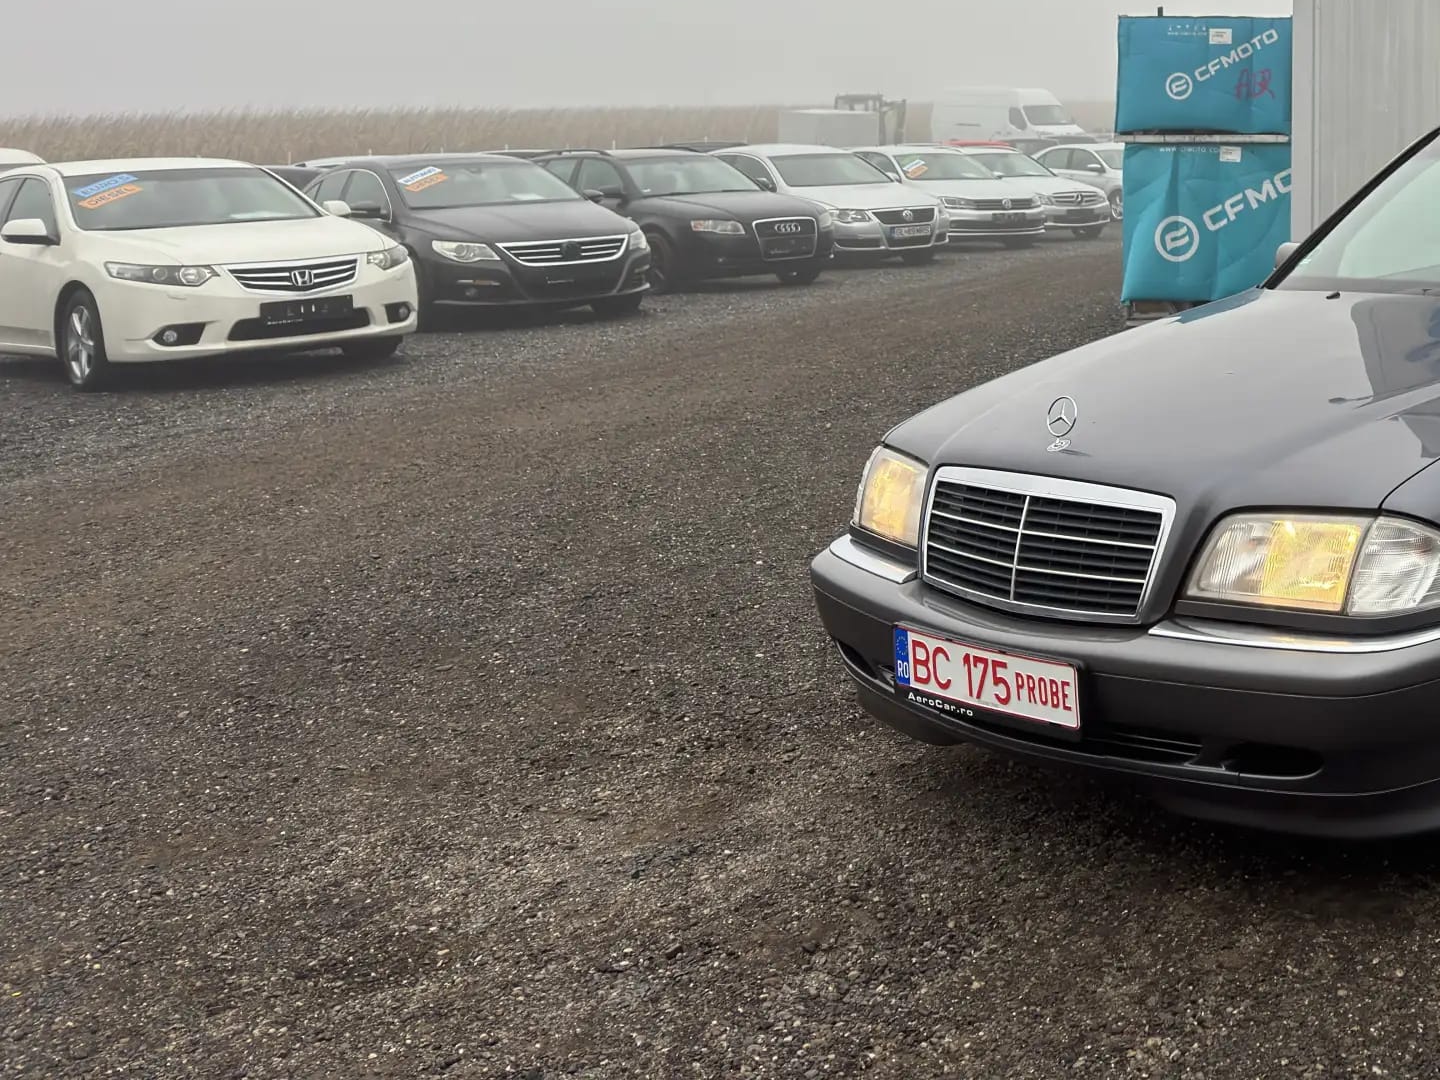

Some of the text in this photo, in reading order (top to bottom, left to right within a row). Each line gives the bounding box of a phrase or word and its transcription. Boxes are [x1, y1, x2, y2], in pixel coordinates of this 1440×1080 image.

[1194, 29, 1279, 82] CFMOTO
[86, 186, 137, 206] DIESEL
[897, 660, 909, 678] RO
[911, 639, 1073, 711] BC 175 PROBE
[908, 691, 974, 717] AeroCar.ro
